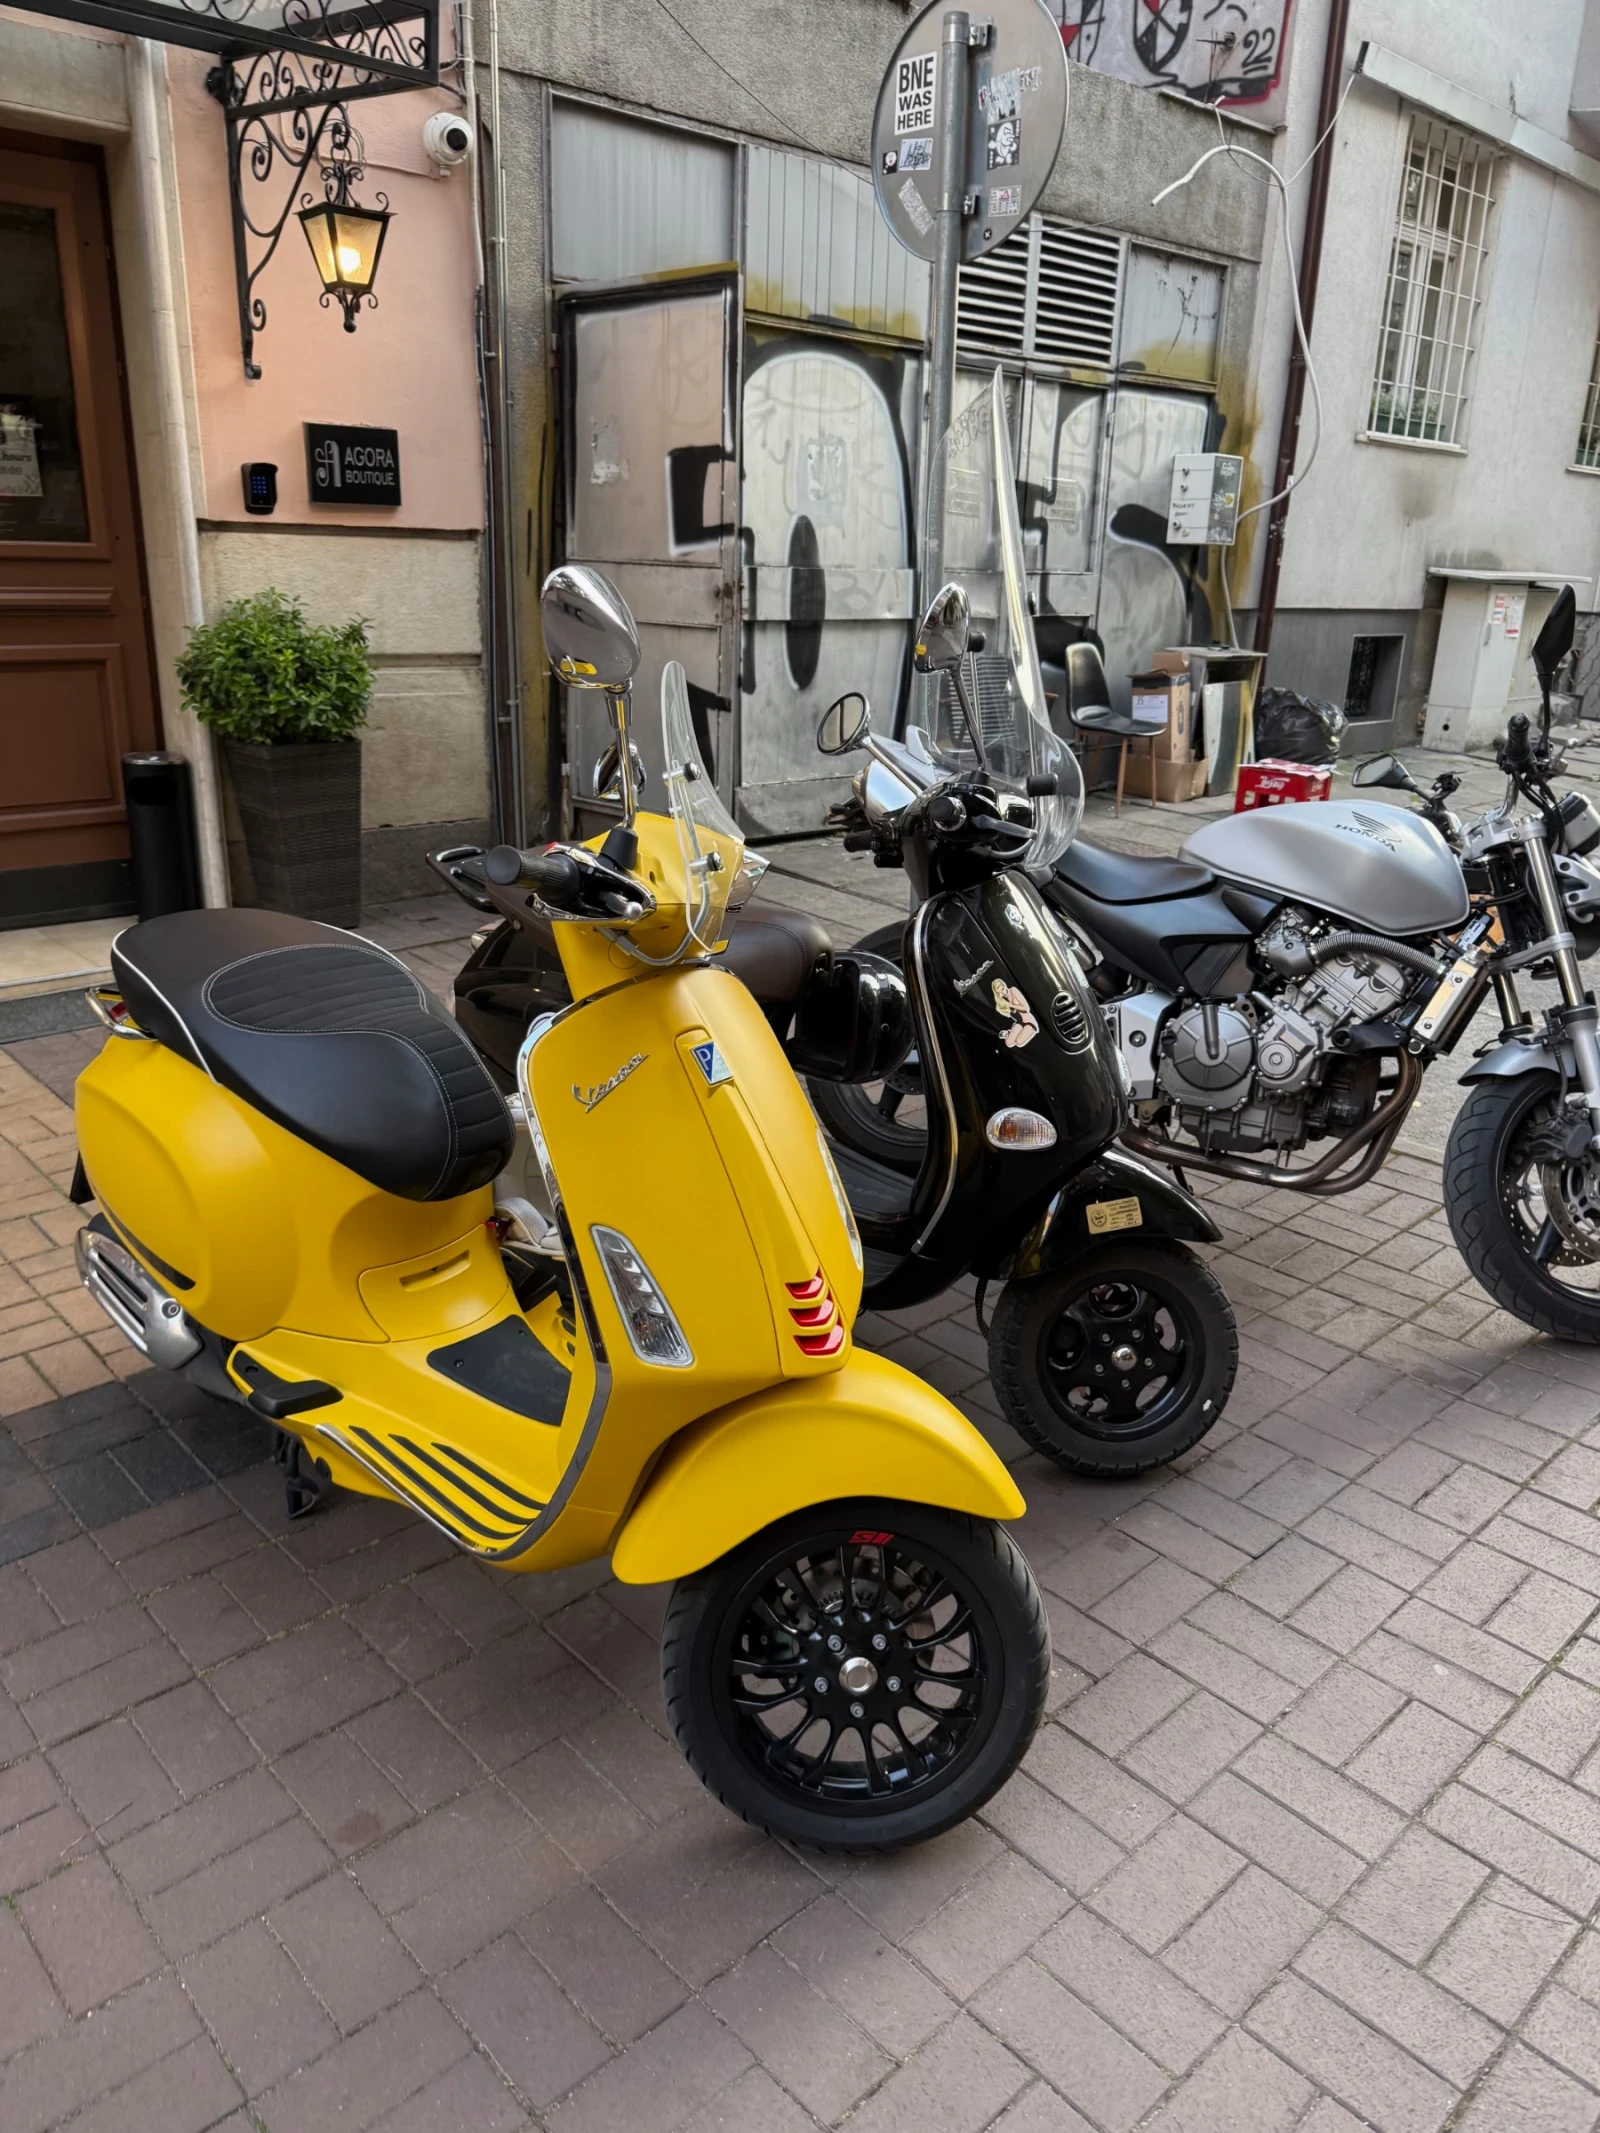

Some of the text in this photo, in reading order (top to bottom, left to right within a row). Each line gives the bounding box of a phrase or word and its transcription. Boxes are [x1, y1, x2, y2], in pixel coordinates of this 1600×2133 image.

[1241, 27, 1276, 68] 22
[899, 56, 934, 94] BNE
[898, 90, 932, 111] WAS
[897, 109, 932, 130] HERE
[344, 446, 395, 468] AGORA
[345, 470, 395, 486] BOUTIQUE
[1333, 824, 1396, 853] HONDA
[571, 1053, 649, 1114] Vespa
